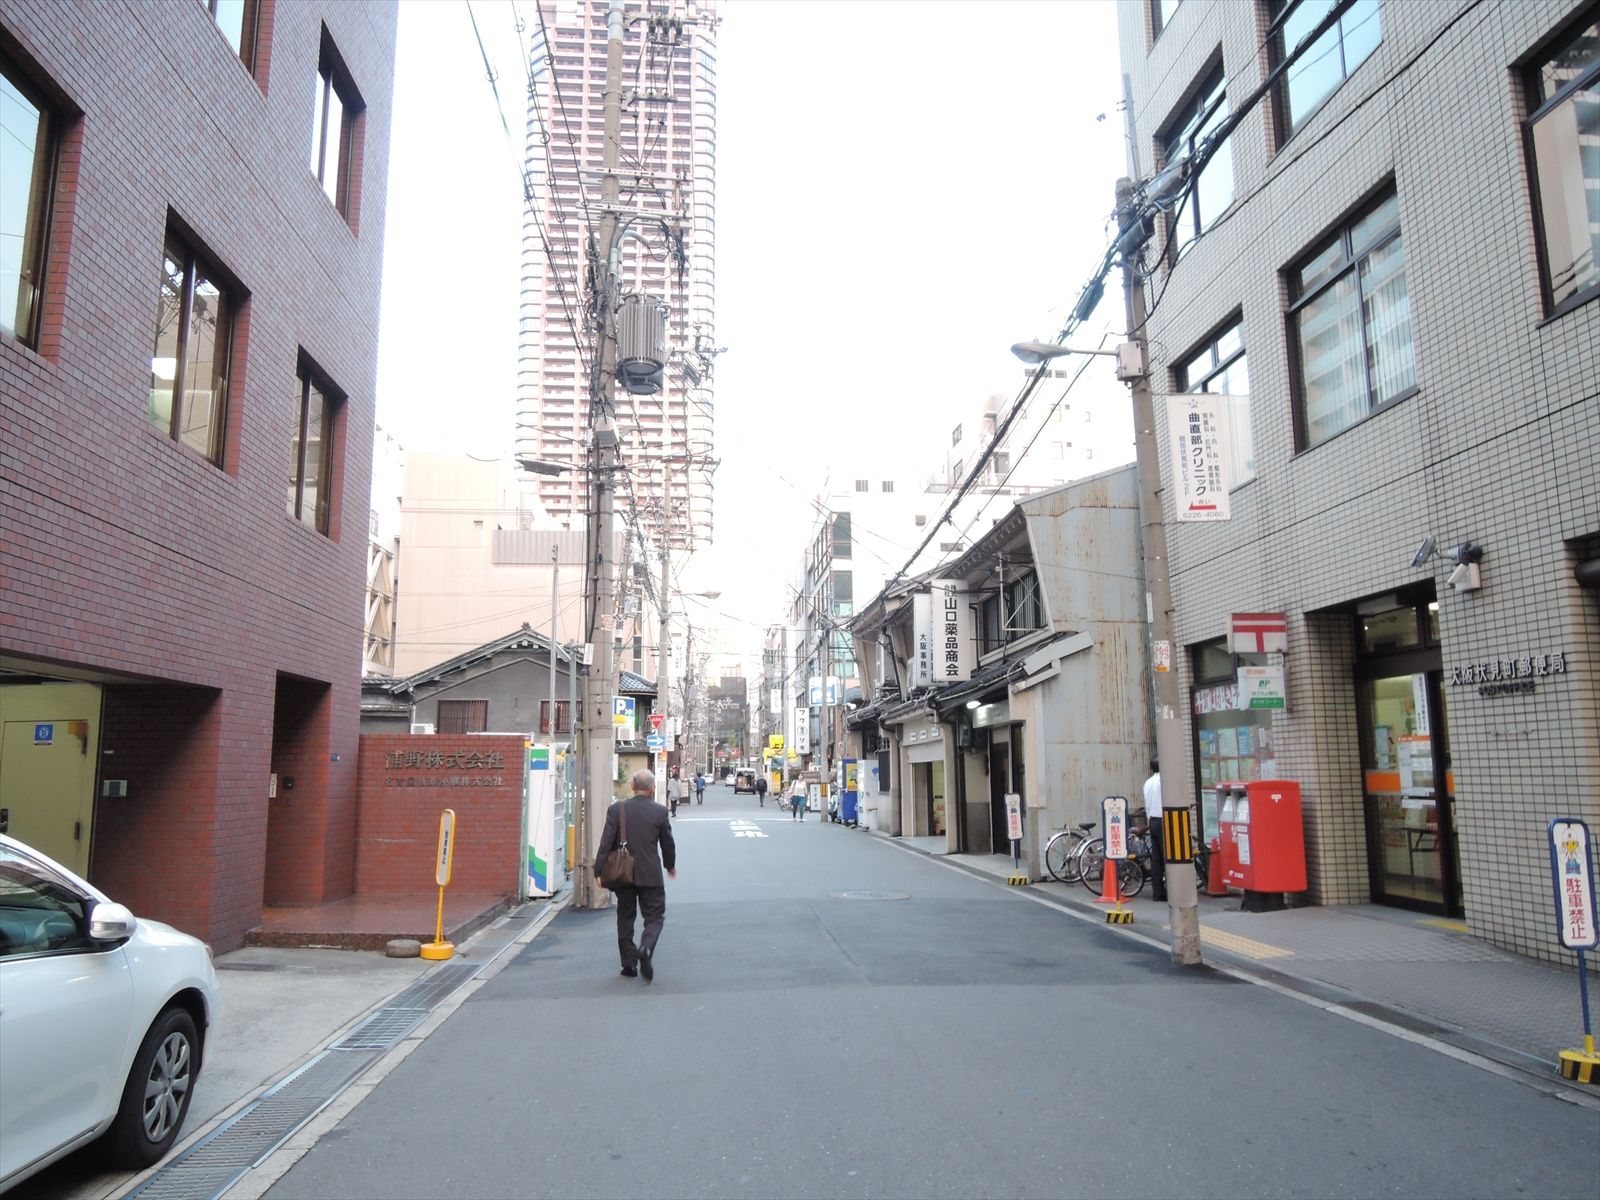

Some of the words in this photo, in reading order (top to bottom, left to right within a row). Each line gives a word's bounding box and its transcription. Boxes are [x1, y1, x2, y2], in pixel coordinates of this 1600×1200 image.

[1188, 412, 1207, 497] 曲直部クリニック
[919, 633, 927, 679] 大阪事務所
[944, 597, 959, 677] 山口薬品商会
[1451, 651, 1566, 686] 大阪伏見町郵便局
[385, 749, 505, 770] 浦野株式会社
[1110, 825, 1121, 856] 駐車禁止
[1566, 878, 1586, 940] 駐車禁止
